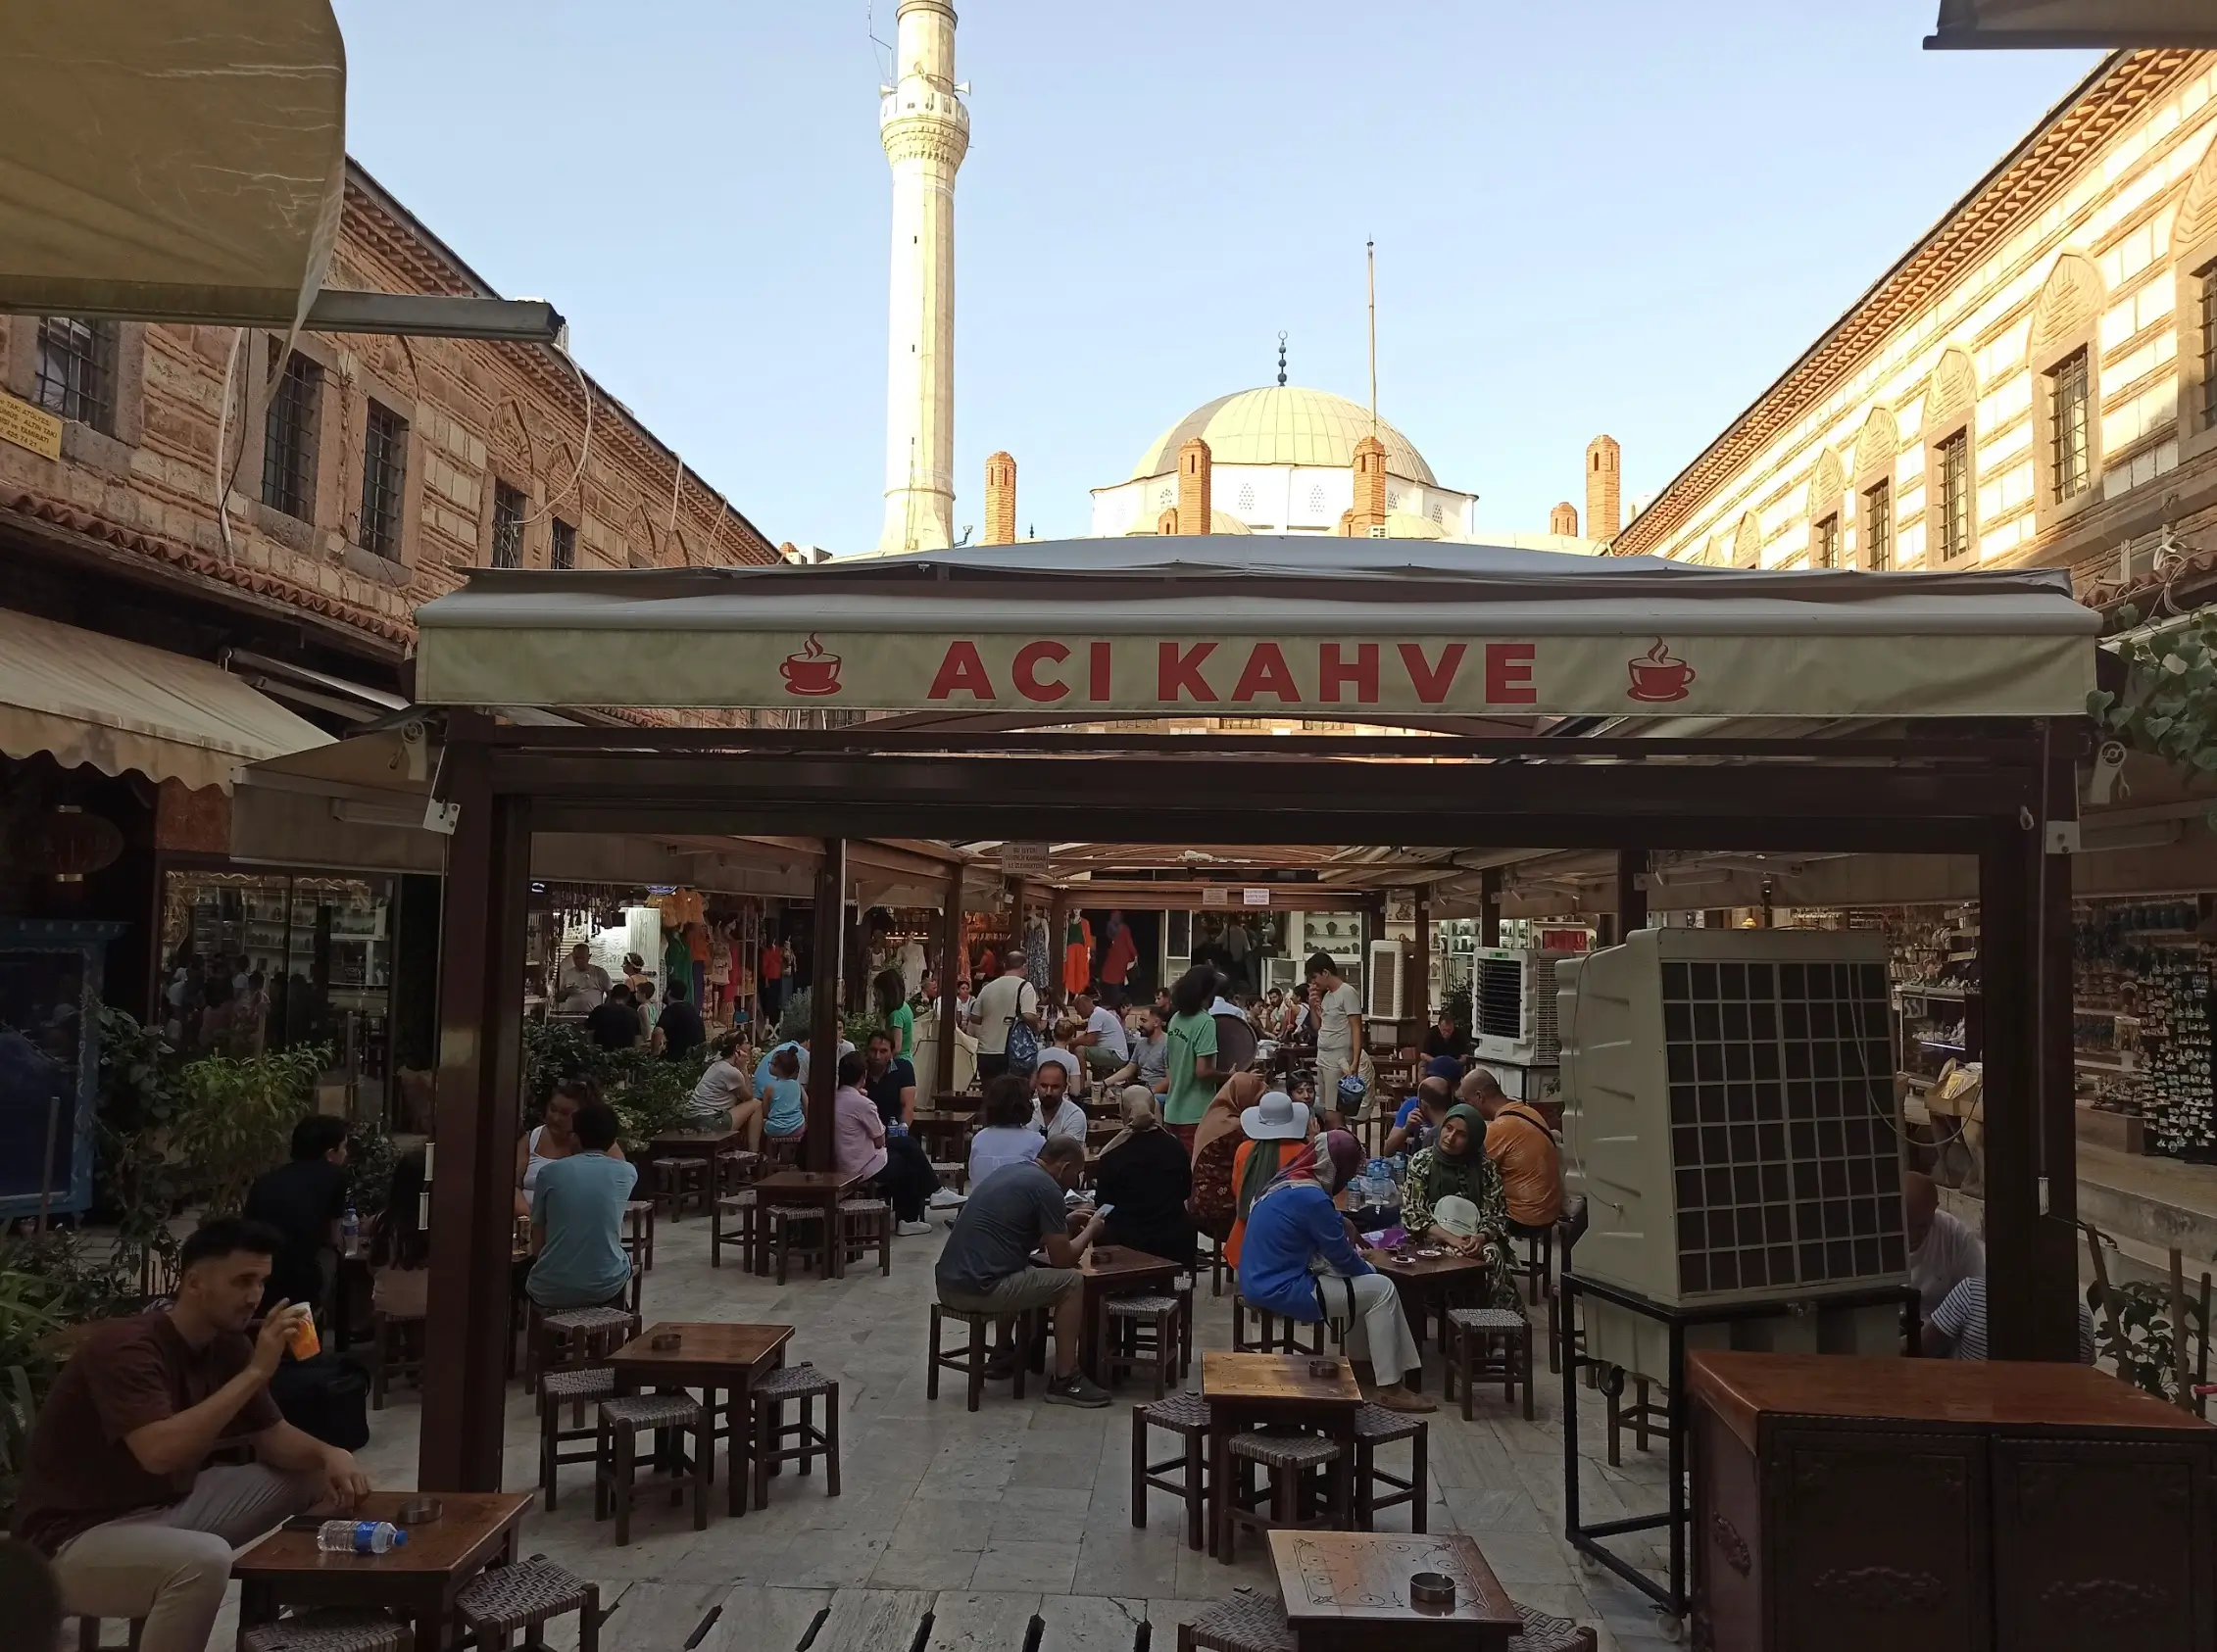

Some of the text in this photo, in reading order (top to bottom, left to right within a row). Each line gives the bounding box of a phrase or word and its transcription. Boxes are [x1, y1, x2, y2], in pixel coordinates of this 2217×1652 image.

[24, 419, 41, 431] ALTIN
[925, 640, 1538, 705] ACI KAHVE
